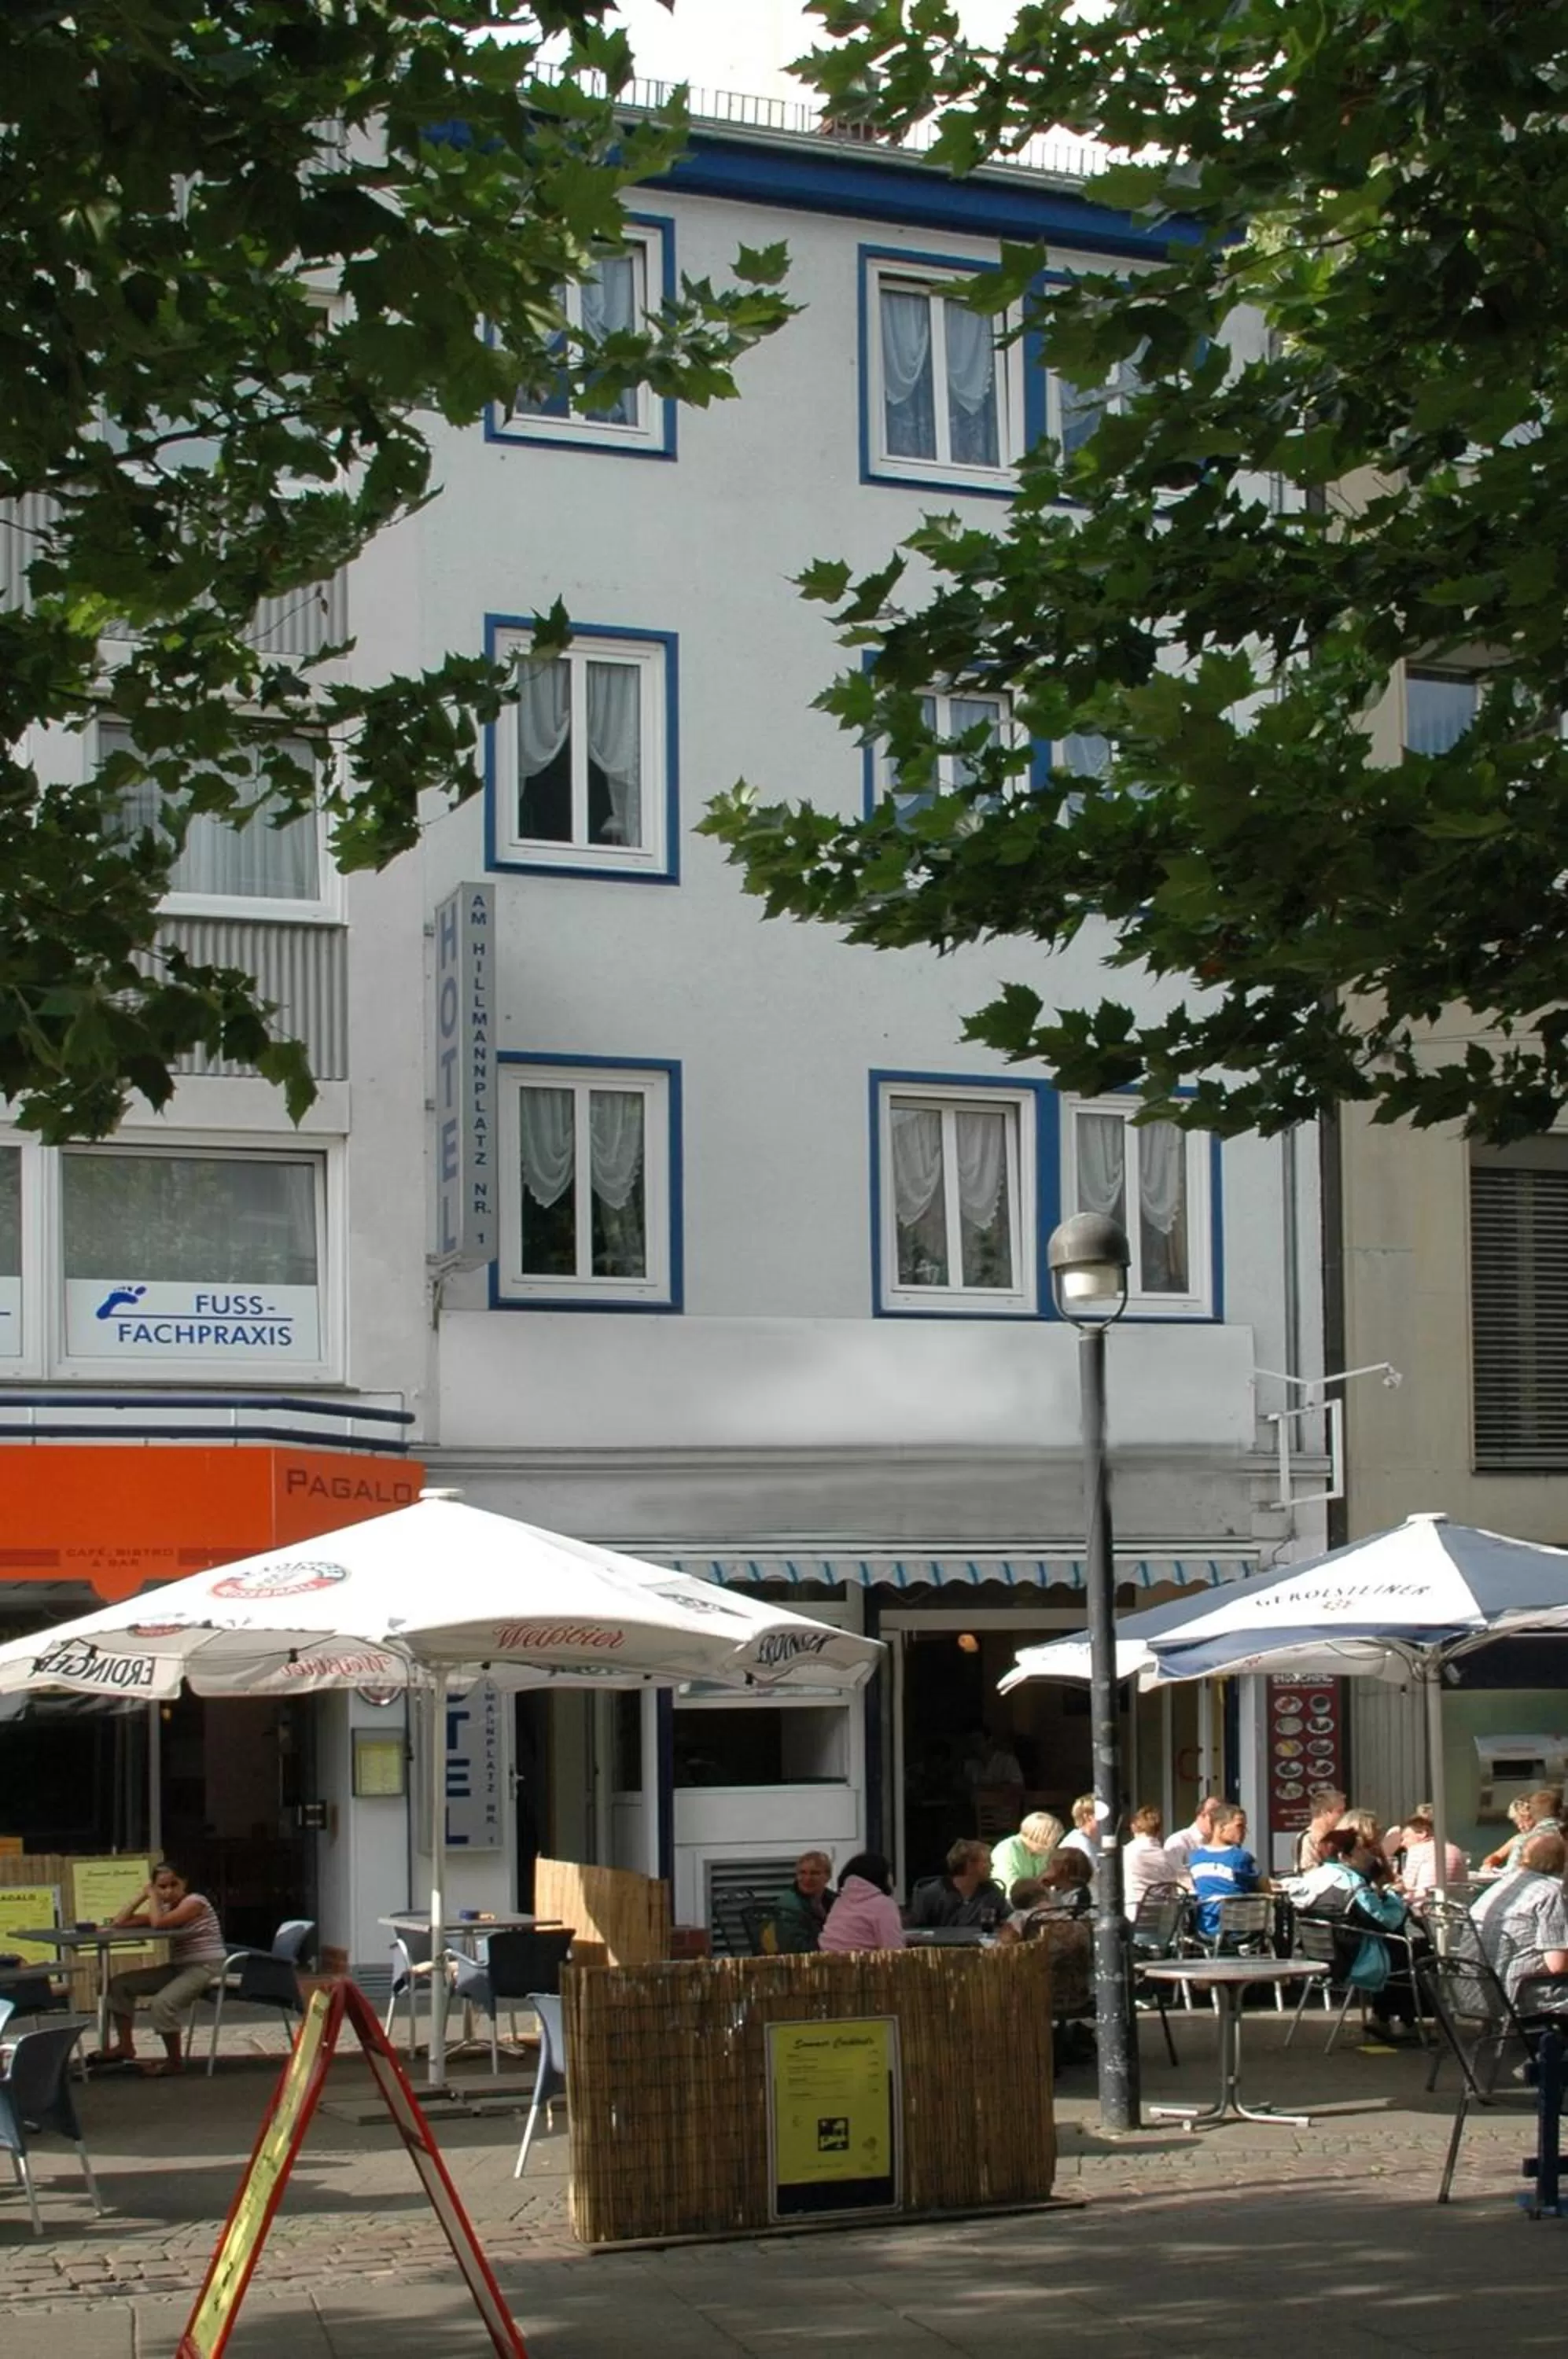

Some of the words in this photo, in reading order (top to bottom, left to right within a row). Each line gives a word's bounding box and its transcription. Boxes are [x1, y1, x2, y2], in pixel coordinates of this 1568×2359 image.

[471, 894, 488, 926] AM
[473, 943, 488, 1165] HILLMANNPLATZ
[440, 902, 458, 1254] HOTEL
[474, 1183, 491, 1214] NR.
[477, 1232, 484, 1244] 1
[194, 1294, 276, 1316] FUSS-
[117, 1323, 293, 1346] FACHPRAXIS
[286, 1468, 413, 1503] PAGALO
[492, 1623, 627, 1649] Weißbier
[445, 1694, 470, 1845] TEL
